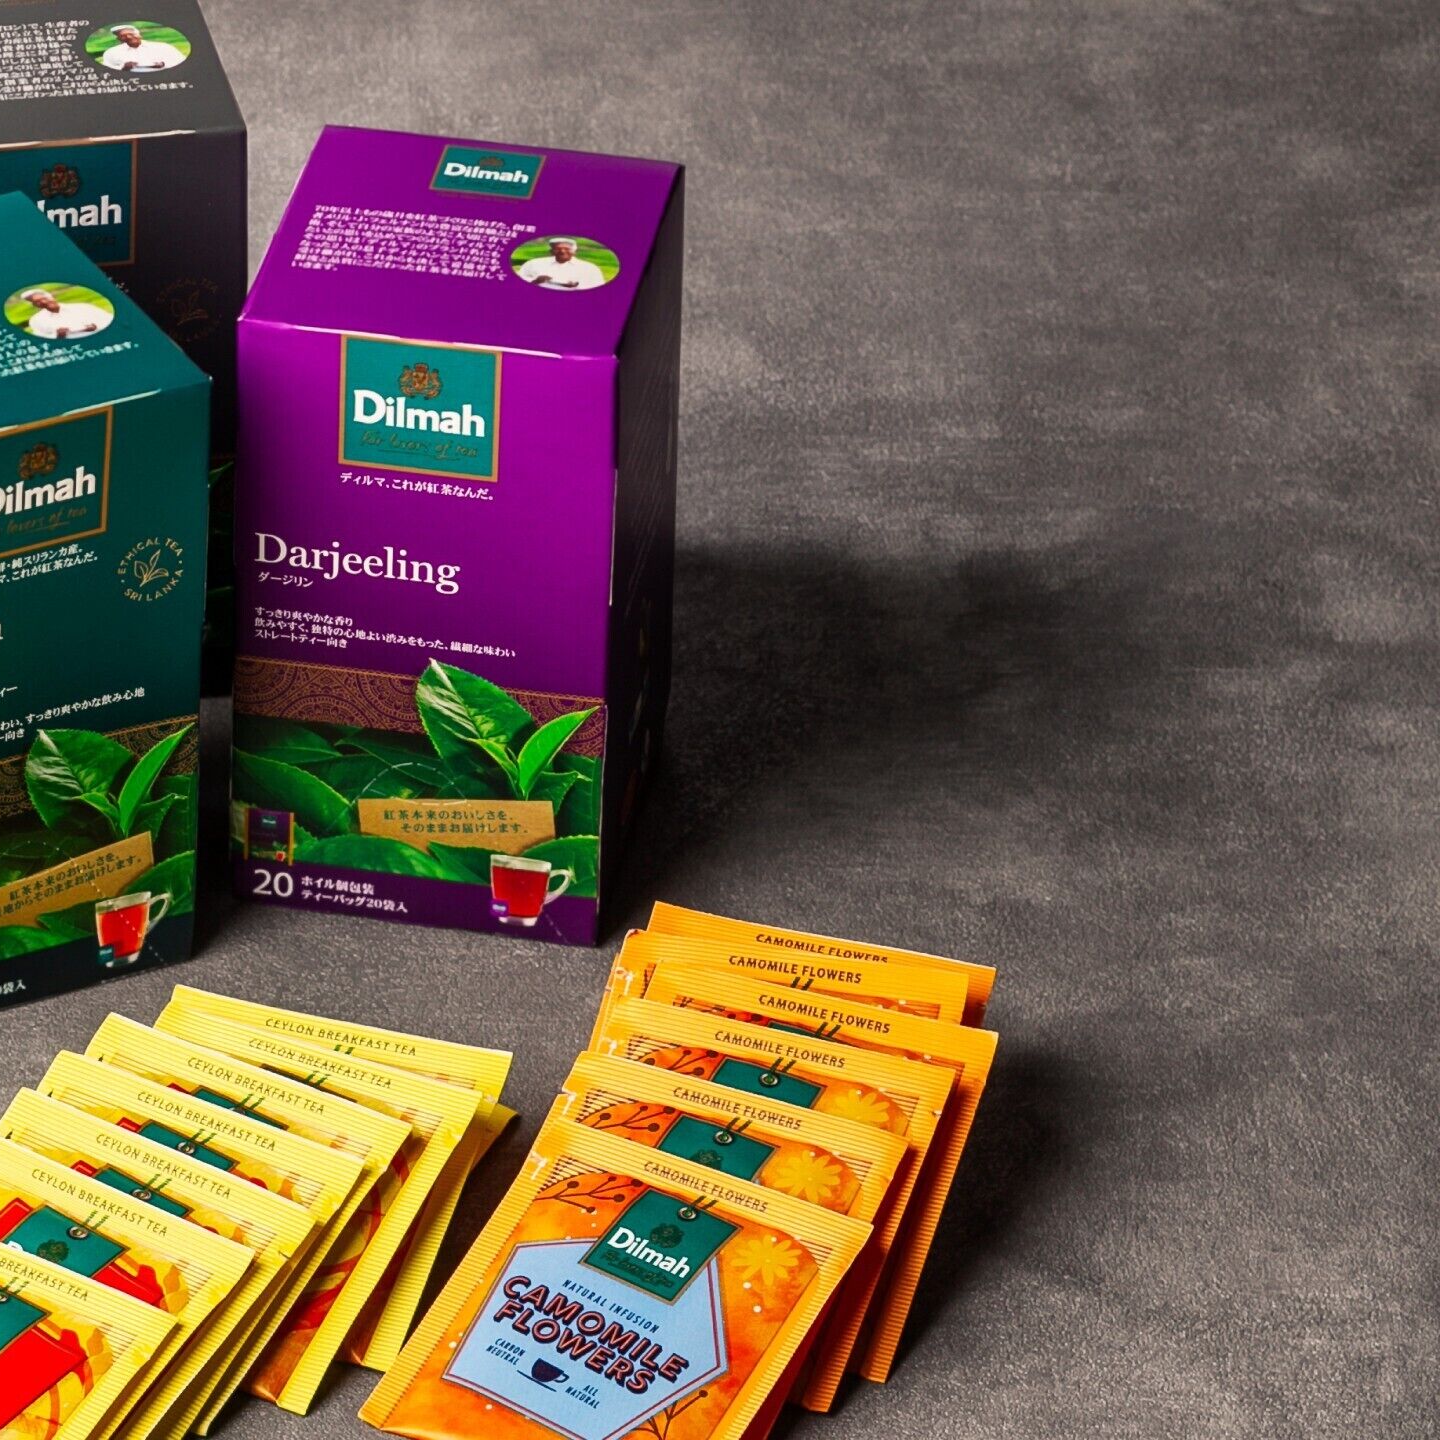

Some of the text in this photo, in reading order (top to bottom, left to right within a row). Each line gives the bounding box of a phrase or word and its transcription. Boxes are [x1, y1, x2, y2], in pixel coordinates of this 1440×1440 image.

[444, 162, 529, 184] Dilmah
[354, 389, 484, 437] Dilmah
[340, 472, 494, 500] ディルマ、これが紅茶なんだ。
[118, 536, 184, 574] ETHICAL TEA
[254, 532, 460, 594] Darjeeling
[123, 568, 184, 602] SRI LANKA
[258, 571, 314, 588] ダージリン
[254, 606, 354, 626] すっきり爽やかな香り
[254, 630, 348, 648] ストレートティー向き
[383, 810, 514, 822] 紅茶本来のおいしさを、
[401, 822, 528, 834] そのままお届けします。
[252, 868, 294, 897] 20
[300, 875, 374, 896] ホイル個包装
[300, 890, 408, 914] ティーバッグ20袋入
[756, 934, 824, 954] CAMOMILE
[728, 955, 862, 984] CAMOMILE FLOWERS
[758, 994, 890, 1034] CAMOMILE FLOWERS
[265, 1018, 416, 1056] CEYLON BREAKFAST TEA
[715, 1030, 846, 1068] CAMOMILE FLOWERS
[248, 1038, 392, 1089] CEYLON BREAKFAST TEA
[187, 1057, 325, 1116] CEYLON BREAKFAST TEA
[136, 1091, 276, 1152] CEYLON BREAKFAST TEA
[673, 1086, 802, 1131] CAMOMILE FLOWERS
[95, 1134, 232, 1200] CEYLON BREAKFAST TEA
[31, 1168, 168, 1237] CEYLON BREAKFAST TEA
[643, 1160, 768, 1213] CAMOMILE FLOWERS
[607, 1226, 690, 1278] Dilmah
[64, 1287, 90, 1303] TEA
[562, 1279, 660, 1334] NATURAL INFUSION
[502, 1275, 690, 1383] CAMOMILE
[486, 1344, 520, 1366] NEUTRAL
[493, 1300, 648, 1394] FLOWERS
[494, 1338, 526, 1356] CARBON
[565, 1386, 600, 1410] NATURAL
[582, 1384, 599, 1397] ALL
